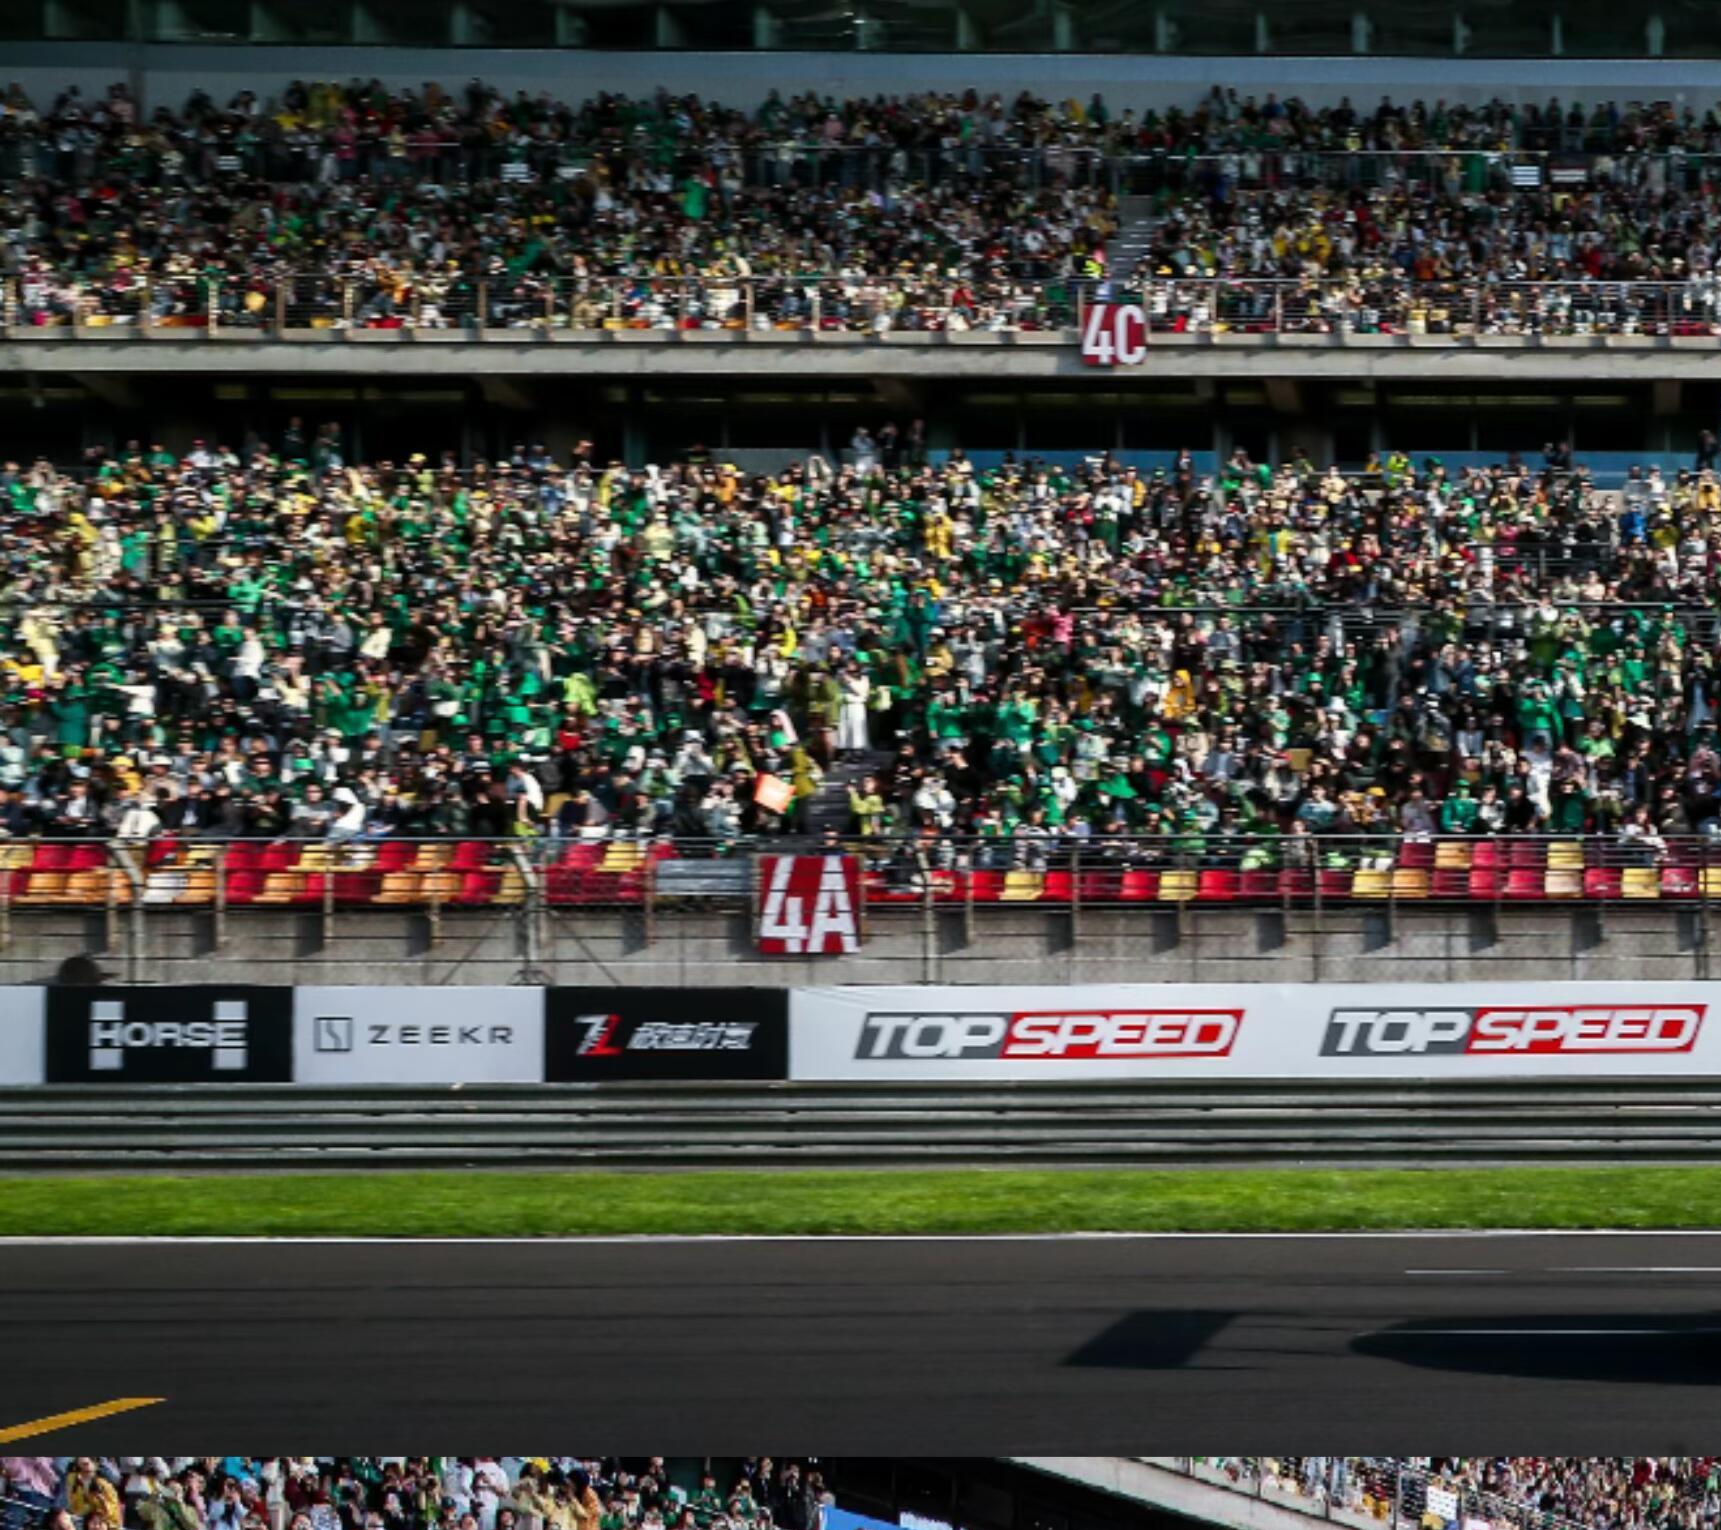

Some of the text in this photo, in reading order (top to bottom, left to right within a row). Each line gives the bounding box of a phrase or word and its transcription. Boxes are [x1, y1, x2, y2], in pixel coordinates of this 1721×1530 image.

[1082, 304, 1146, 363] 4C
[759, 856, 861, 953] 4A
[368, 1025, 513, 1044] ZEEKR
[868, 1013, 1238, 1057] TOP SPEED
[1331, 1008, 1702, 1052] TOP SPEED
